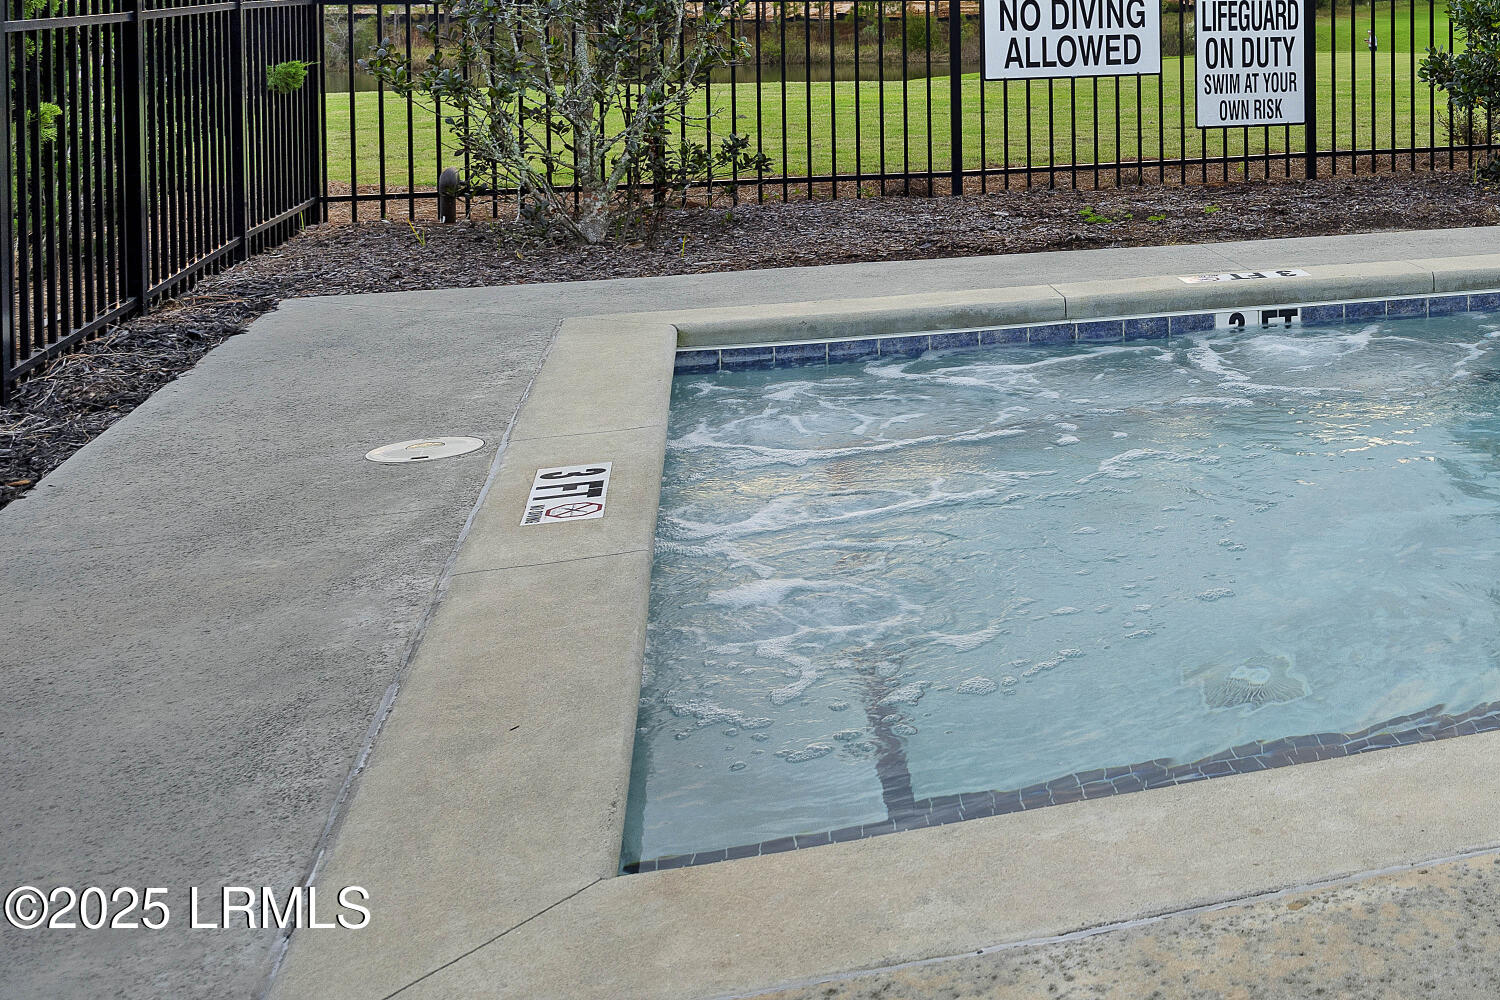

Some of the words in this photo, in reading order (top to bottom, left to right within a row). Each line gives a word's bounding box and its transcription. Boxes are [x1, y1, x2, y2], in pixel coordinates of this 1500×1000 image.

[1202, 0, 1299, 32] LIFEGUARD
[1004, 34, 1141, 69] ALLOWED
[1205, 37, 1233, 69] ON
[1241, 36, 1296, 68] DUTY
[1204, 73, 1240, 95] SWIM
[1244, 73, 1260, 94] AT
[1264, 71, 1297, 93] YOUR
[1219, 99, 1249, 121] OWN
[1254, 98, 1283, 120] RISK
[1230, 272, 1268, 281] FT
[540, 468, 606, 479] 3
[533, 480, 604, 500] FT
